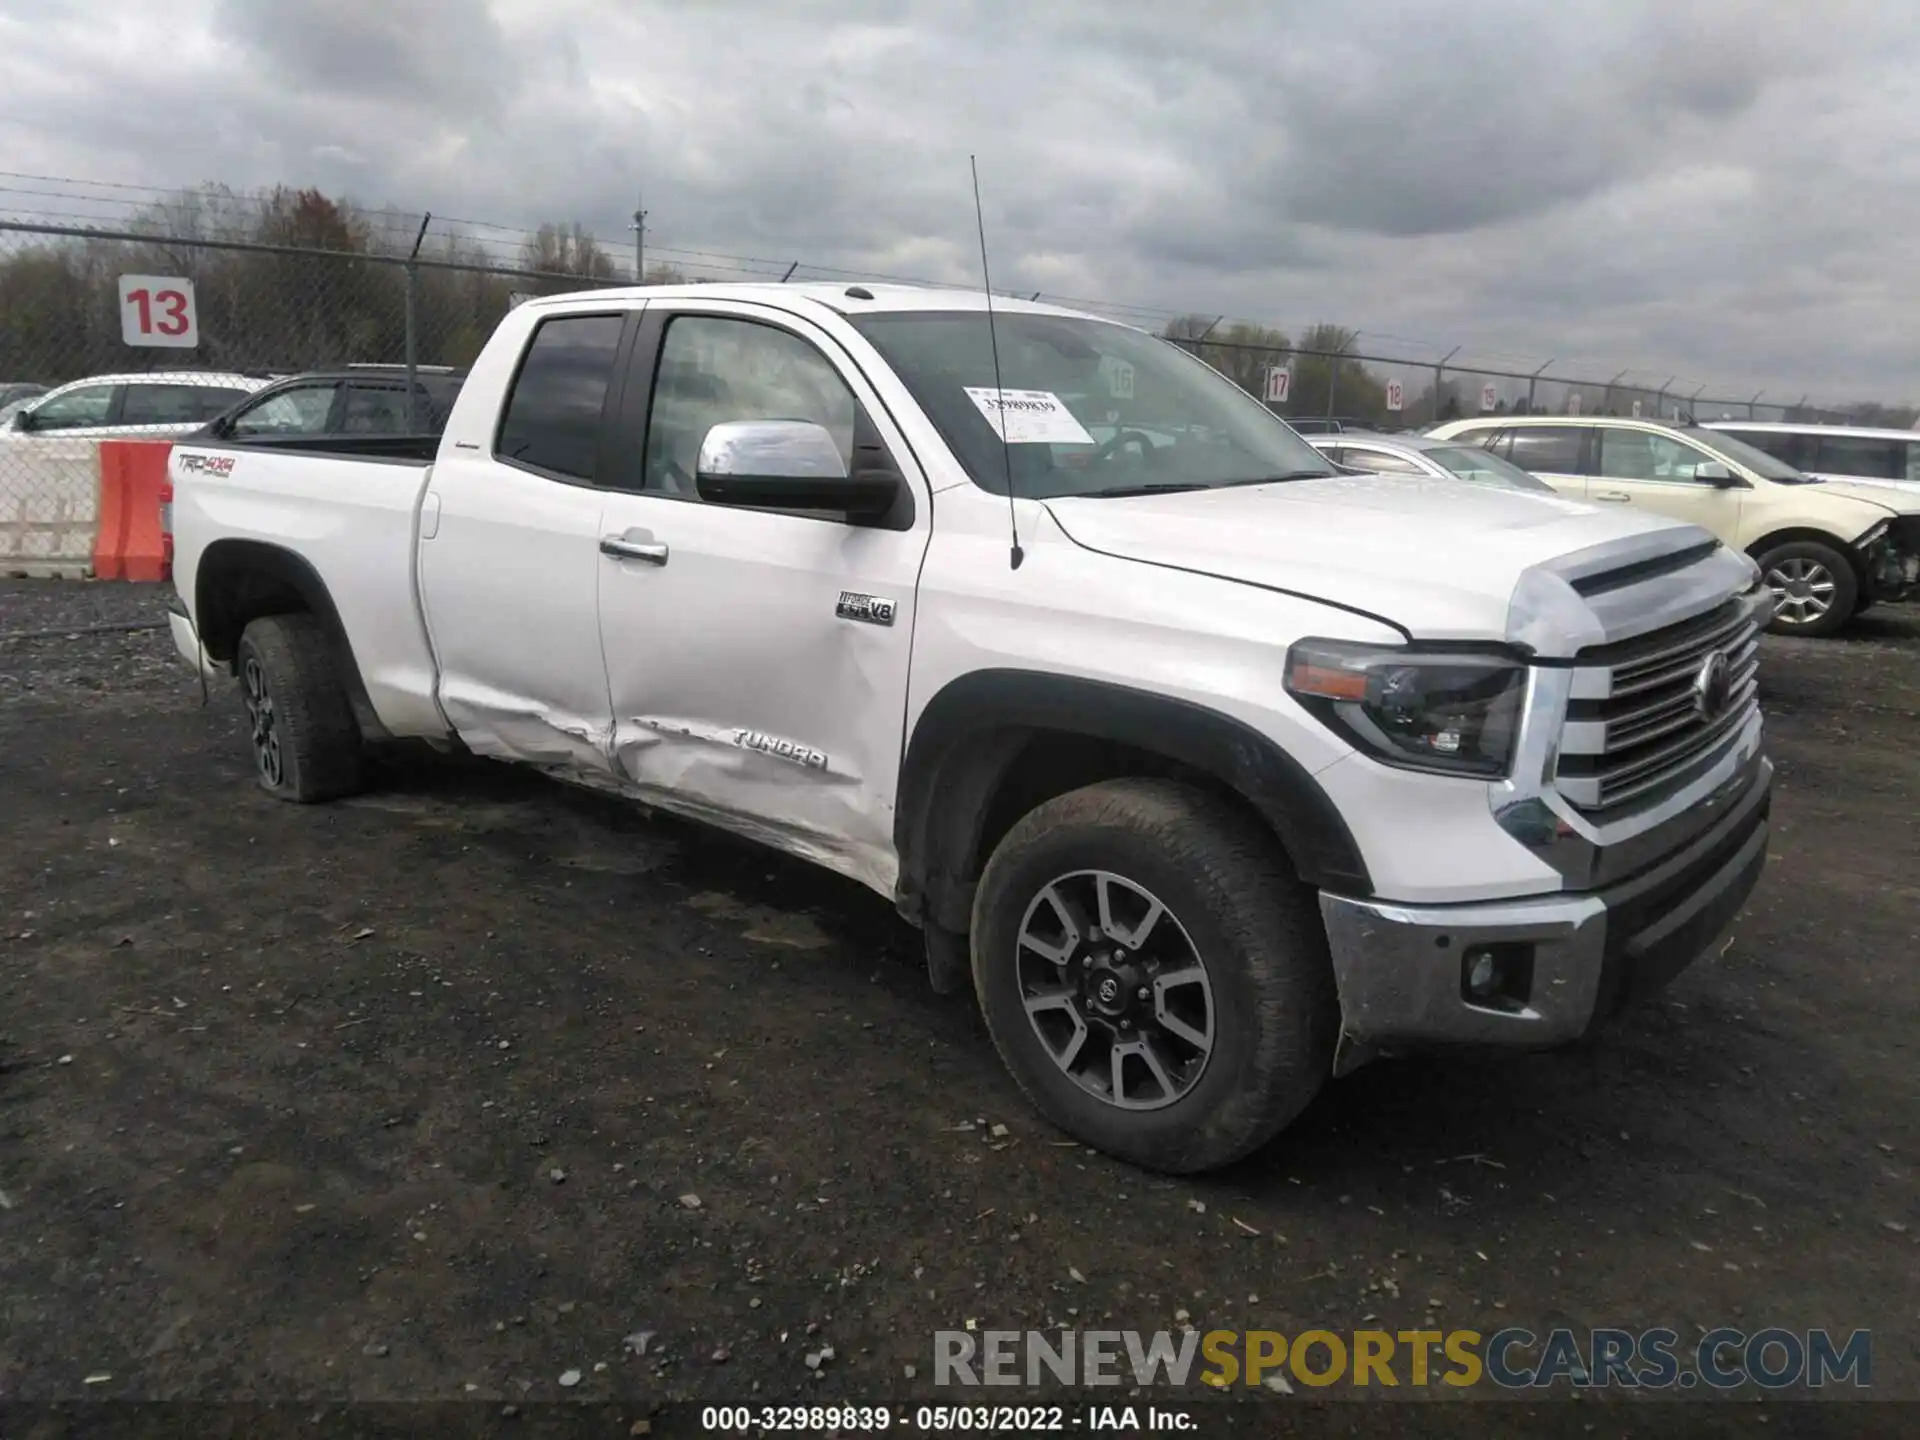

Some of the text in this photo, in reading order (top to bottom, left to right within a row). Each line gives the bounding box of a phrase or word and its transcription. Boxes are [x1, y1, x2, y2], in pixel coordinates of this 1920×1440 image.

[127, 288, 189, 336] 13
[1113, 366, 1132, 392] 16
[1271, 373, 1288, 397] 17
[1389, 385, 1401, 406] 18
[871, 602, 892, 619] V8
[732, 728, 828, 771] TUNDRA
